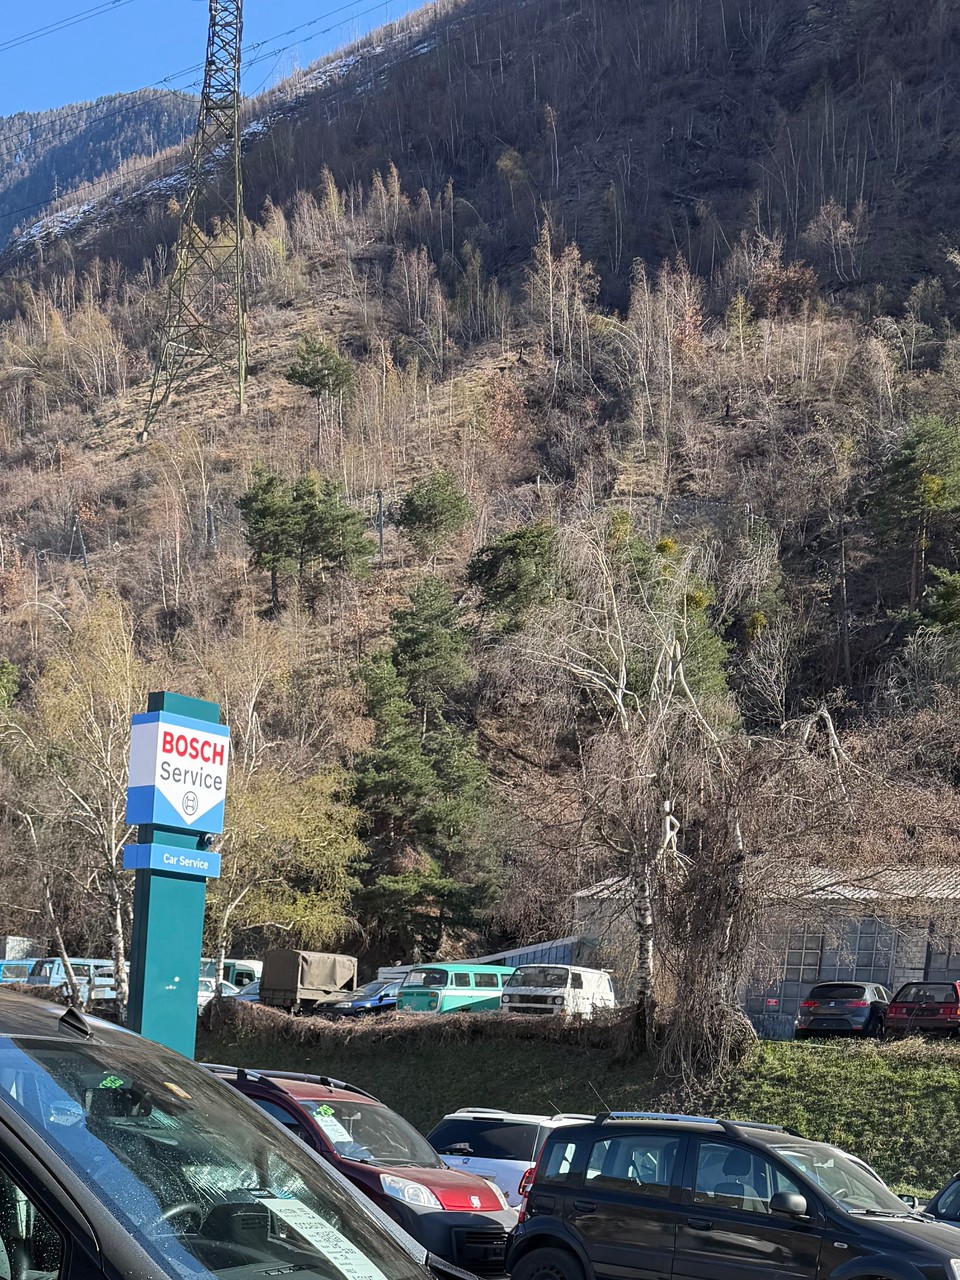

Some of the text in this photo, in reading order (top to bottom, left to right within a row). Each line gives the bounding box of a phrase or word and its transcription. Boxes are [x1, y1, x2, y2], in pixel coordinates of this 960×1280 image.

[162, 731, 224, 766] BOSCH
[160, 761, 223, 791] Service
[163, 853, 209, 870] Car Service
